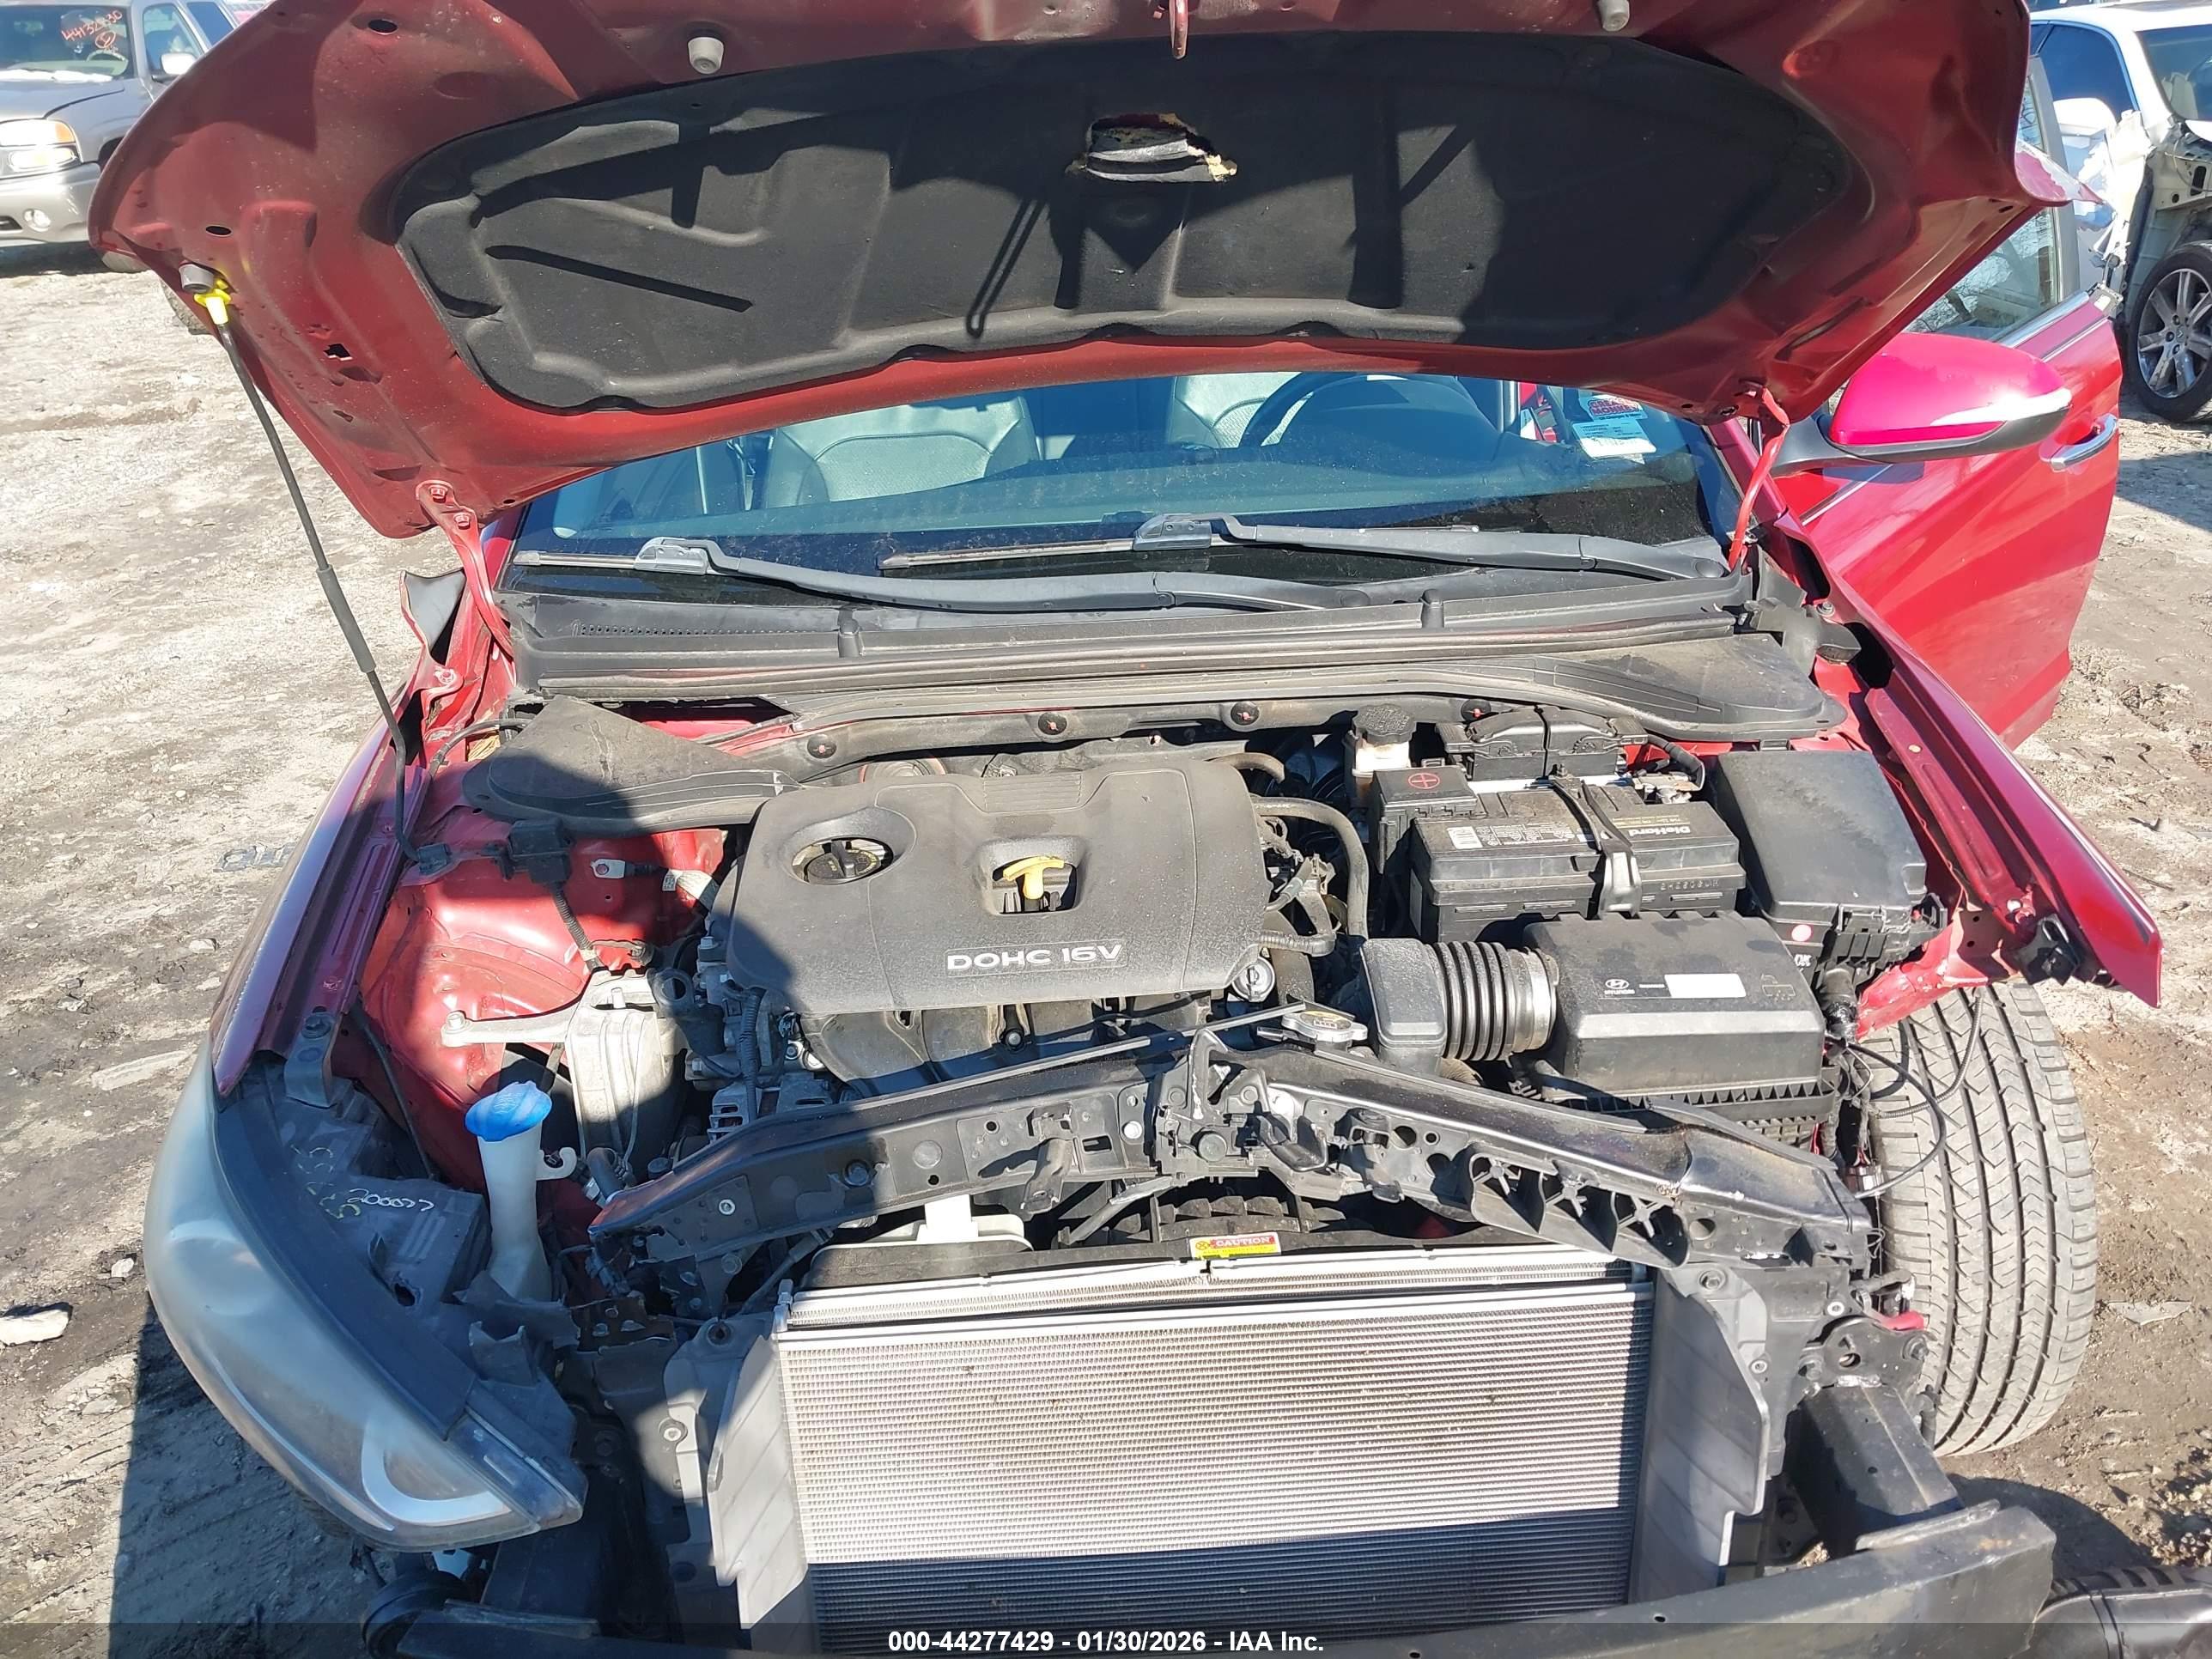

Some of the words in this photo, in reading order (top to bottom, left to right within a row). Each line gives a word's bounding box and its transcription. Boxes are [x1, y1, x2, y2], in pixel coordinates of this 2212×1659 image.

[1628, 825, 1691, 837] DieHard
[947, 949, 1052, 971] DOHC
[1062, 944, 1122, 963] 16V
[1216, 1236, 1270, 1247] CAUTION
